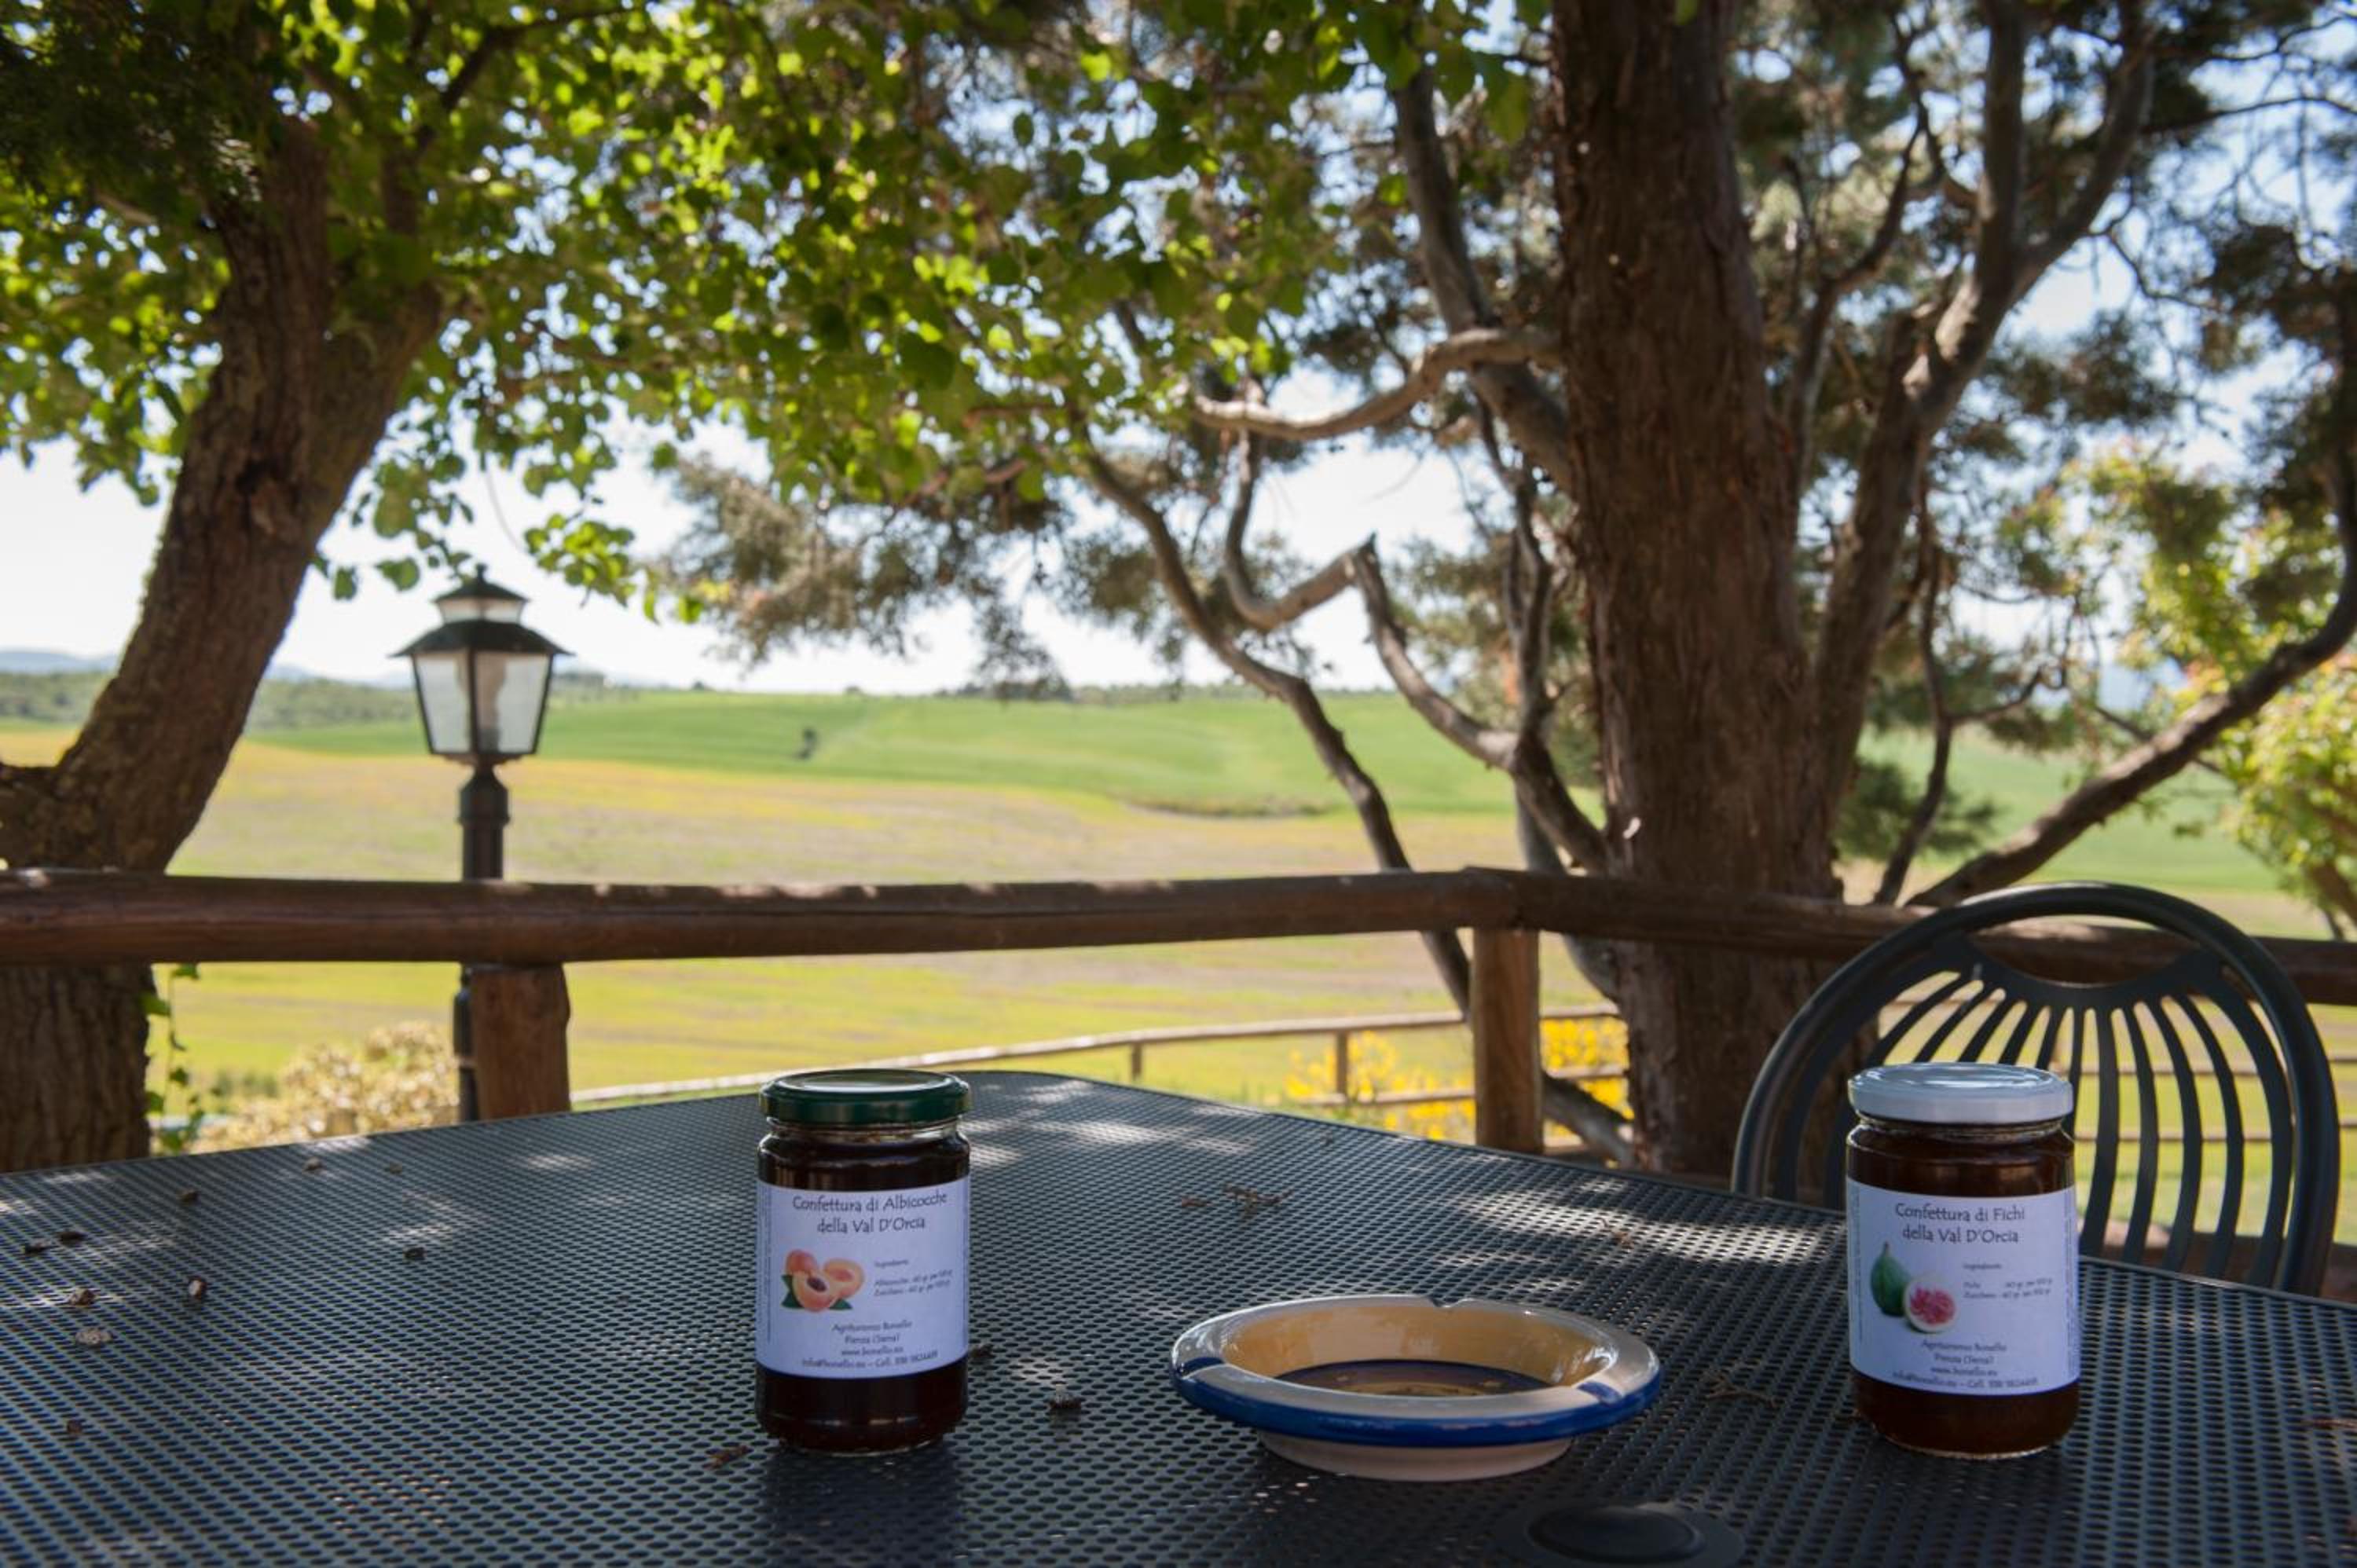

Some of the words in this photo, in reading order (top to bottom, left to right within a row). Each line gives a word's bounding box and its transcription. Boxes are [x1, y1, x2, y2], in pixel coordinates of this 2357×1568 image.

[793, 1195, 861, 1211] Confettura
[866, 1196, 878, 1211] di
[882, 1189, 948, 1210] Albicocche
[1895, 1203, 1970, 1222] Confettura
[1975, 1206, 1988, 1221] di
[1993, 1204, 2025, 1220] Fichi
[817, 1220, 847, 1233] della
[852, 1219, 874, 1233] Val
[1902, 1225, 1934, 1243] della
[1939, 1227, 1961, 1243] Val
